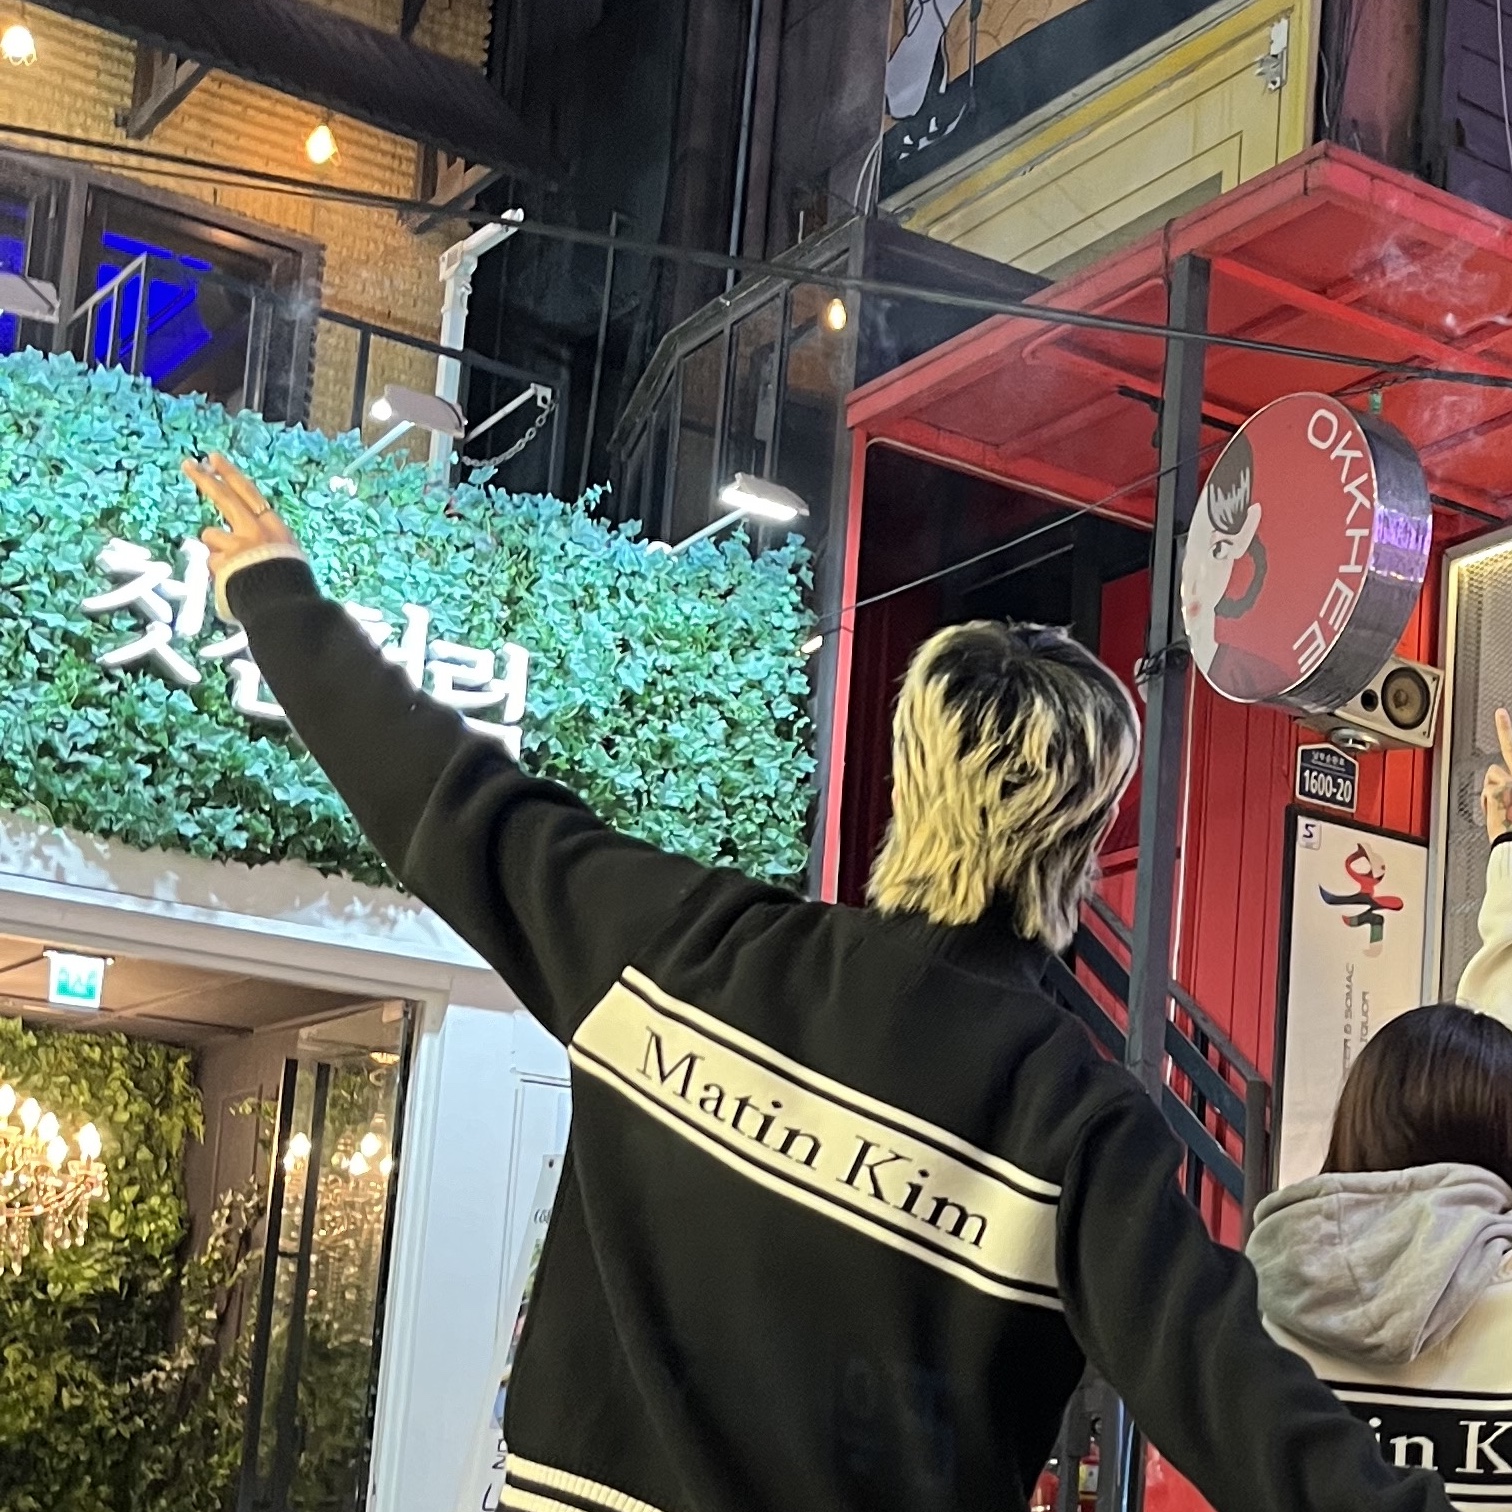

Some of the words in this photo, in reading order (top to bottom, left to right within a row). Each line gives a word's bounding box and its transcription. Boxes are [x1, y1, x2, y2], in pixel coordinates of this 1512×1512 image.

[1291, 406, 1379, 677] OKKHEE
[1303, 769, 1353, 803] 1600-20
[636, 1026, 829, 1171] Matin
[836, 1134, 989, 1249] Kim
